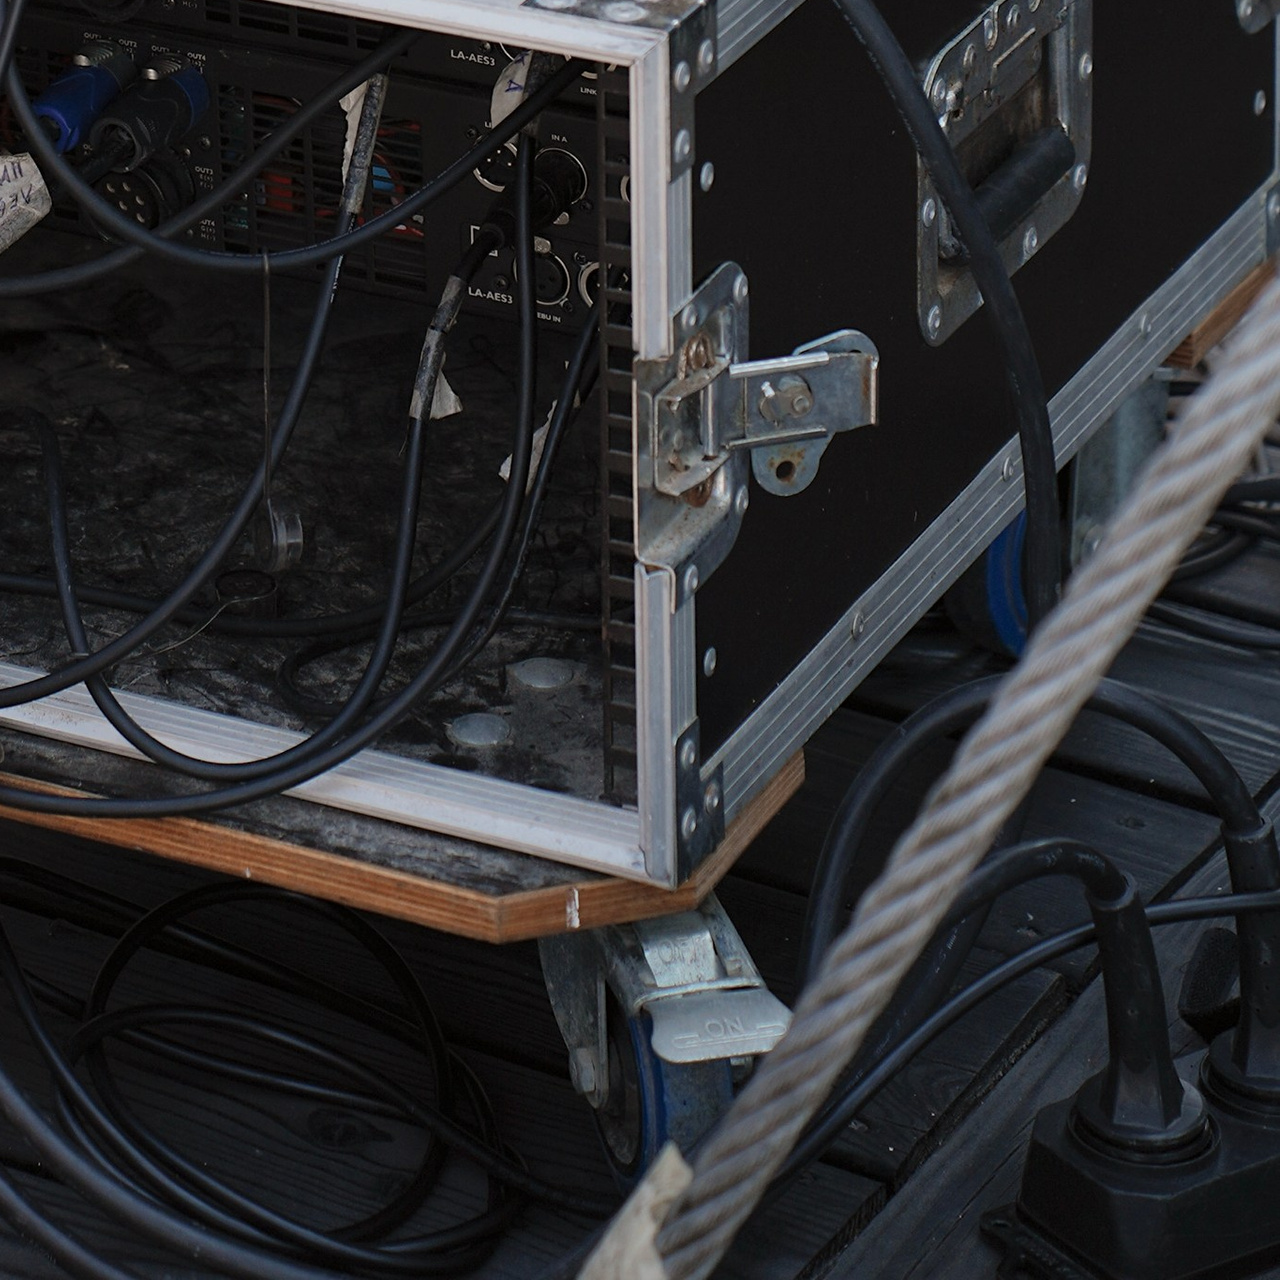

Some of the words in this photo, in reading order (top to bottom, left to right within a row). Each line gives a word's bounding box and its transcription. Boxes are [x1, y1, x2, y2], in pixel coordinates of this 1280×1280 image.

[450, 49, 496, 67] LA-AES3
[580, 86, 598, 96] LINK
[468, 286, 514, 305] LA-AES3
[704, 1015, 745, 1039] ON
